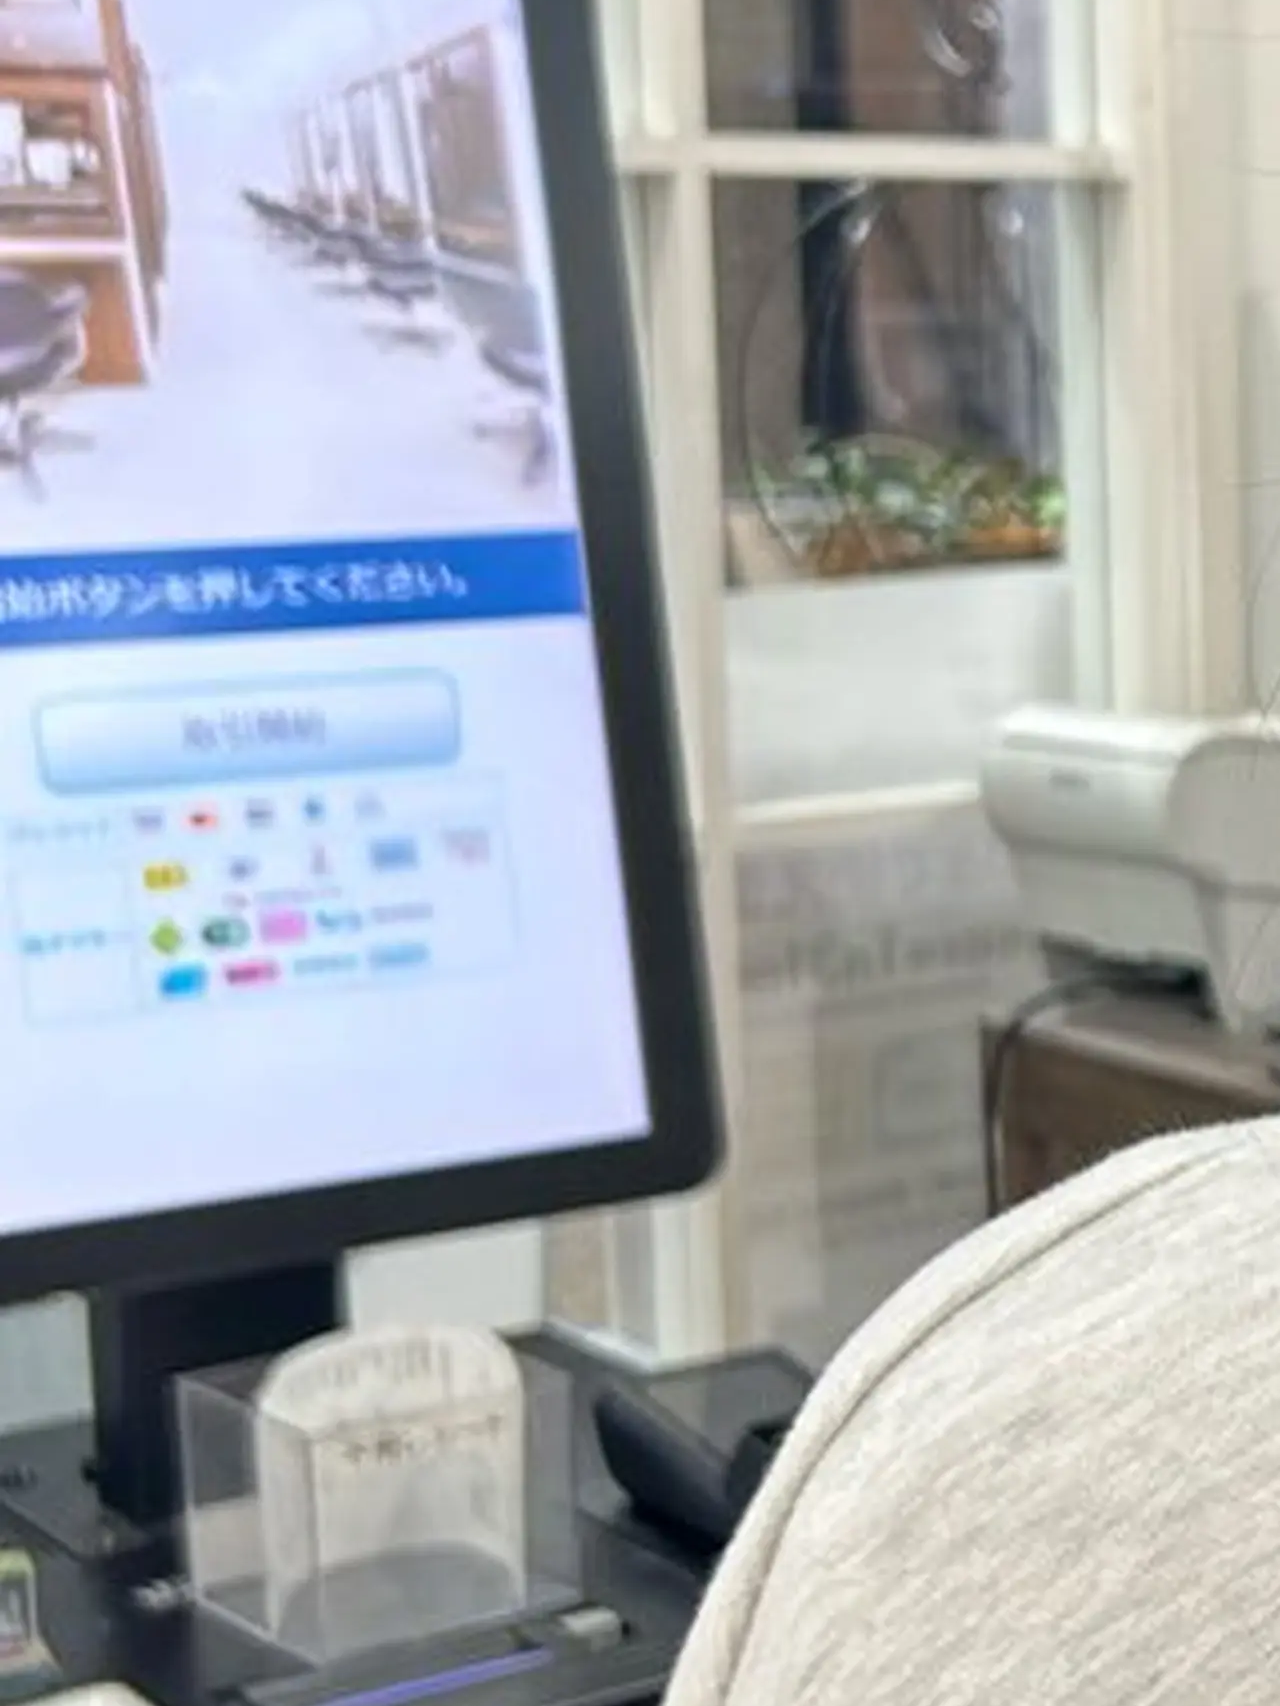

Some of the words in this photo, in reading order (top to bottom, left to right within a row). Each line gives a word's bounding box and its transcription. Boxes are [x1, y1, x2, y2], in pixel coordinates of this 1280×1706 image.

[0, 558, 469, 625] 始ボタンを押してください。
